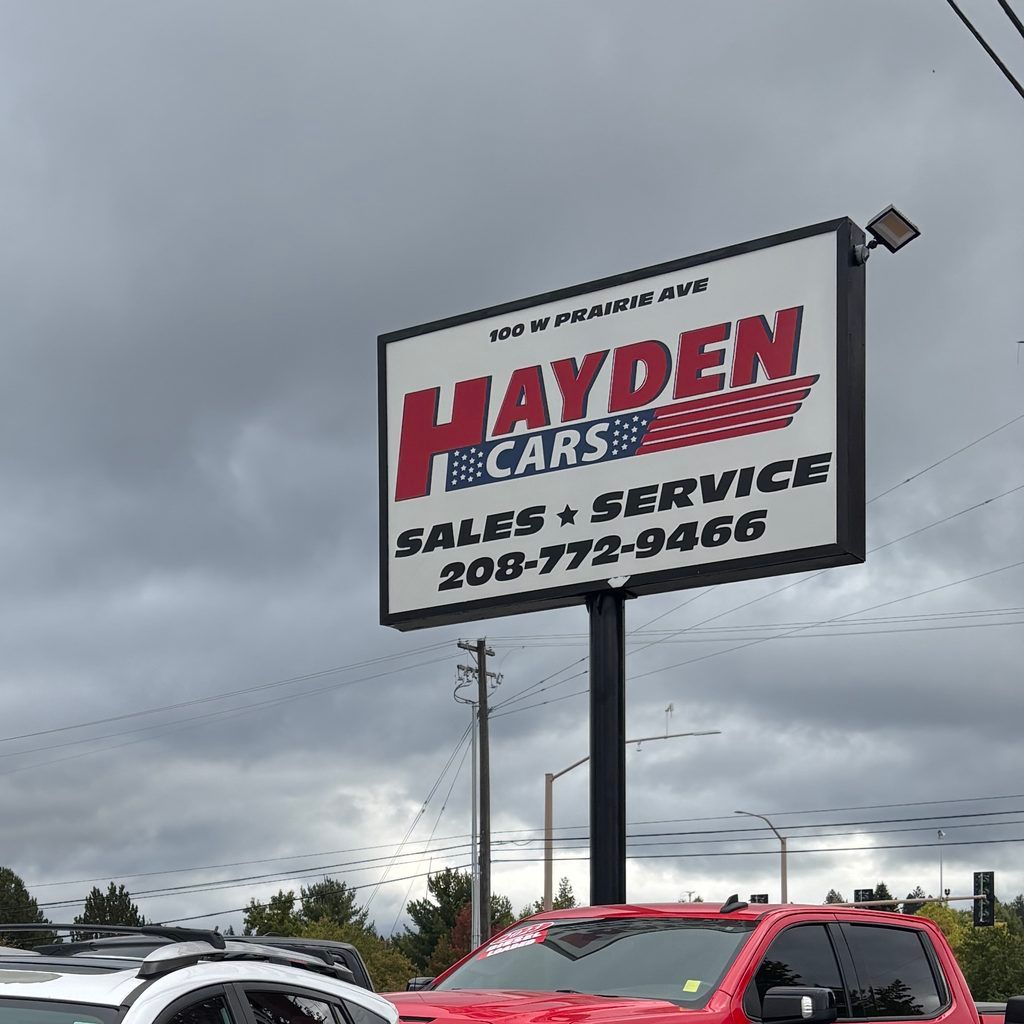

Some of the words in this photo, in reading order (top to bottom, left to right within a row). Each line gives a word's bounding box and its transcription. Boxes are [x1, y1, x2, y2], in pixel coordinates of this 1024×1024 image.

[489, 323, 525, 342] 100
[530, 316, 551, 333] W
[554, 291, 654, 328] PRAIRIE
[657, 277, 709, 303] AVE
[395, 305, 804, 502] HAYDEN
[485, 421, 612, 479] CARS
[395, 505, 546, 558] SALES
[590, 452, 832, 524] SERVICE
[438, 509, 768, 592] 208-772-9466
